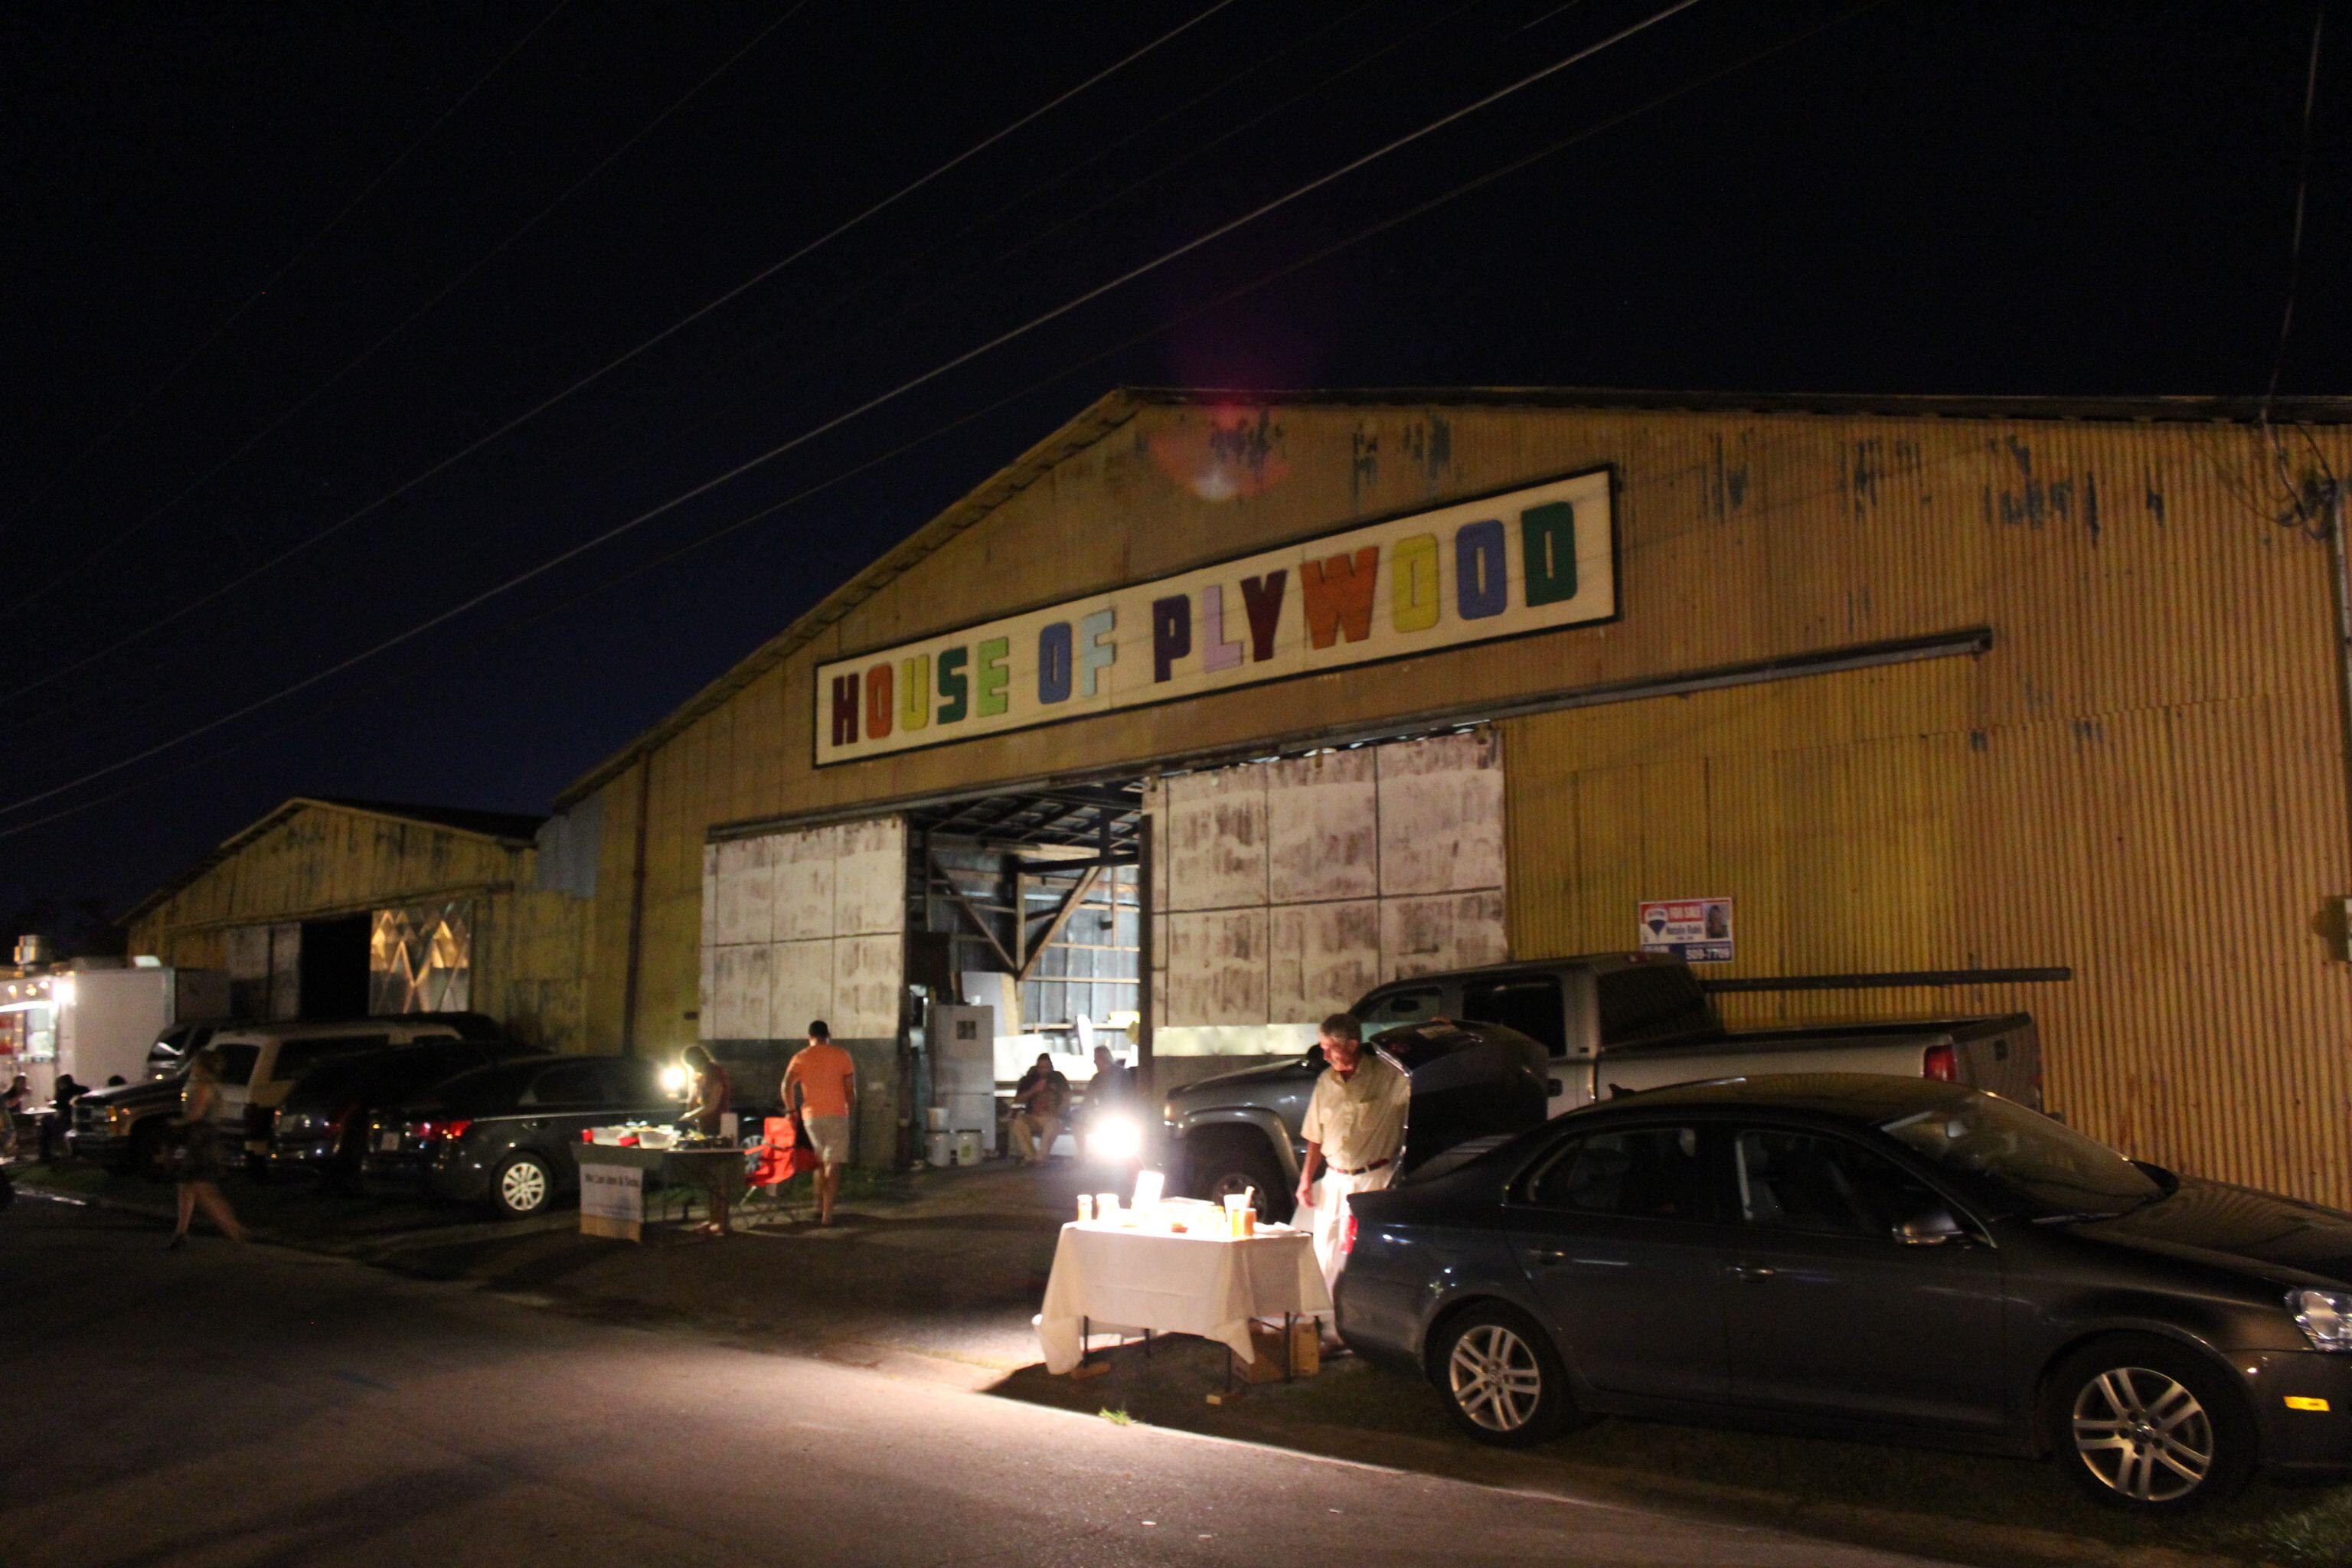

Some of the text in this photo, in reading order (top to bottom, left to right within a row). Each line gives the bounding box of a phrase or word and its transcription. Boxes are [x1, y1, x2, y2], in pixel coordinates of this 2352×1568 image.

[832, 501, 1577, 746] HOUSE OF PLYWOOD
